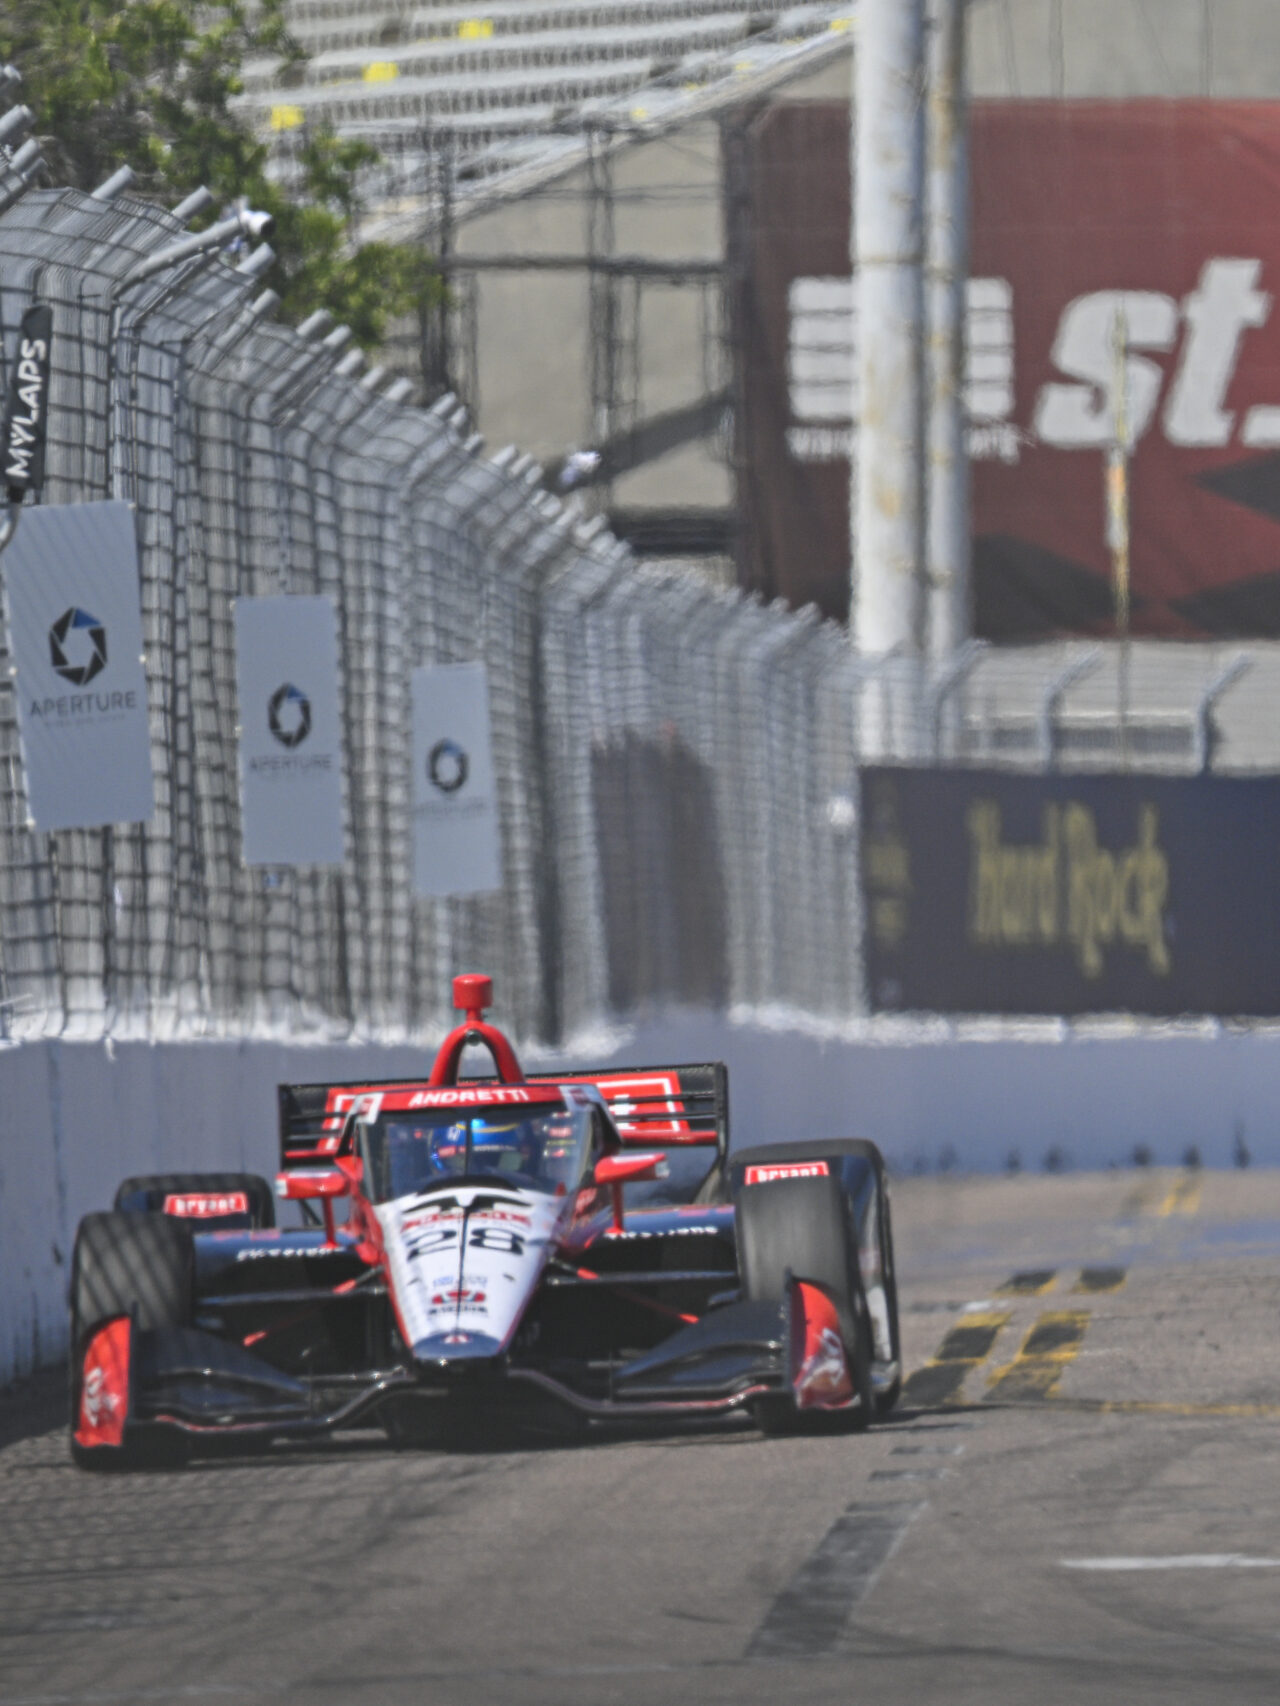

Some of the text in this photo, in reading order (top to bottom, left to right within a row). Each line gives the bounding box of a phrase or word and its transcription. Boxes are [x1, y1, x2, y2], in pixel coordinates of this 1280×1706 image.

[5, 338, 47, 478] MYLAPS
[30, 690, 137, 718] APERTURE
[409, 1089, 529, 1107] ANDRETTI
[406, 1227, 526, 1263] 28
